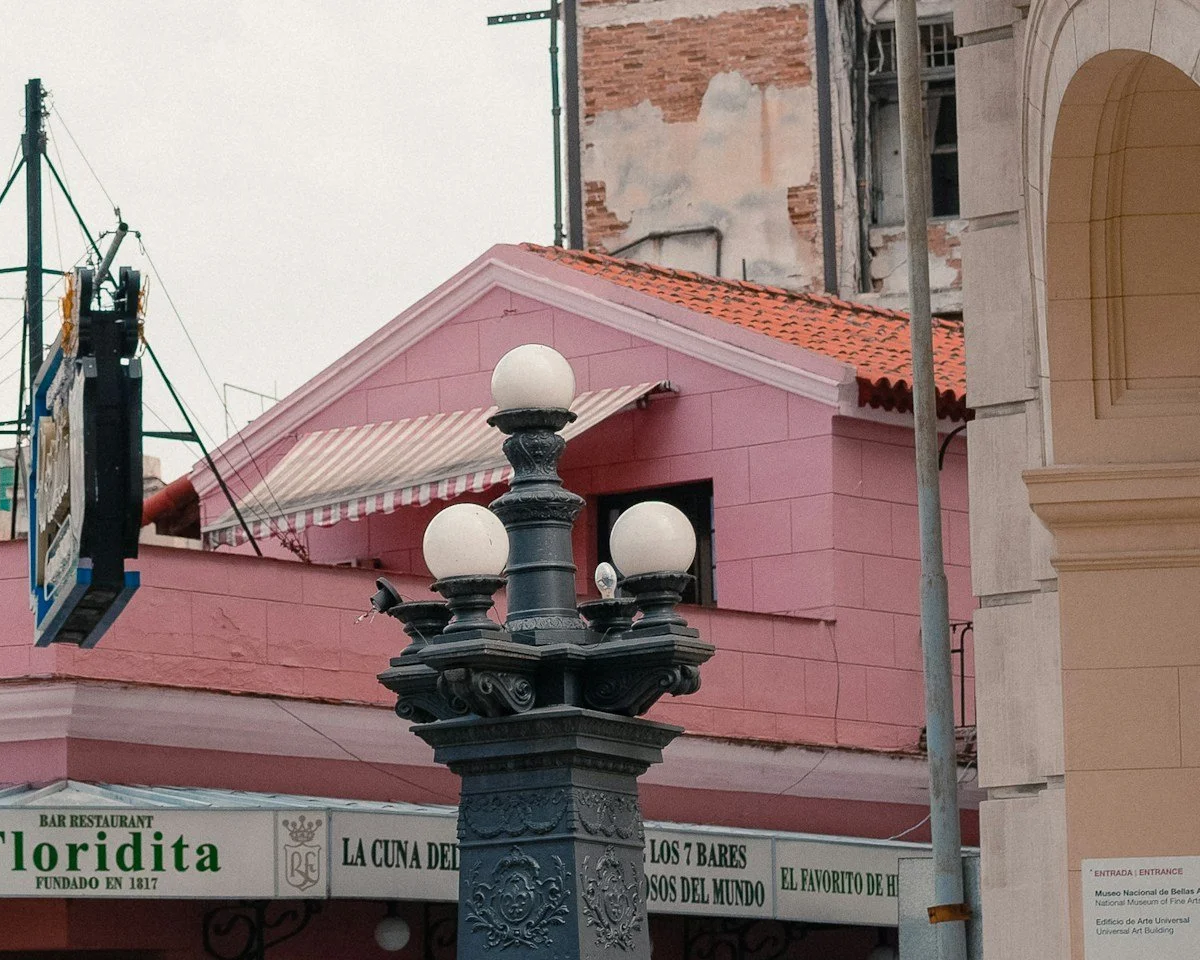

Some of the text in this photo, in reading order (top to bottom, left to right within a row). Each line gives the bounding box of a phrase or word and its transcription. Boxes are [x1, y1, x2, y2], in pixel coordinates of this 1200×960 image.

[39, 814, 154, 828] BAR RESTAURANT
[342, 837, 366, 866] LA
[371, 839, 421, 869] CUNA
[650, 839, 679, 865] LOS
[684, 842, 693, 867] 7
[696, 842, 747, 869] BARES
[1139, 868, 1183, 876] ENTRANCE
[35, 876, 158, 890] FUNDADO EN 1817
[781, 866, 797, 891] EL
[800, 867, 863, 895] FAVORITO
[867, 872, 883, 896] DE
[681, 876, 709, 904] DEL
[713, 877, 764, 907] MUNDO
[1123, 888, 1157, 897] Nacional
[1159, 888, 1169, 896] de
[1095, 899, 1126, 907] National
[1096, 918, 1123, 926] Edificio
[1137, 917, 1153, 925] Arte
[1155, 916, 1190, 924] Universal
[1096, 926, 1174, 936] Universal Art Building
